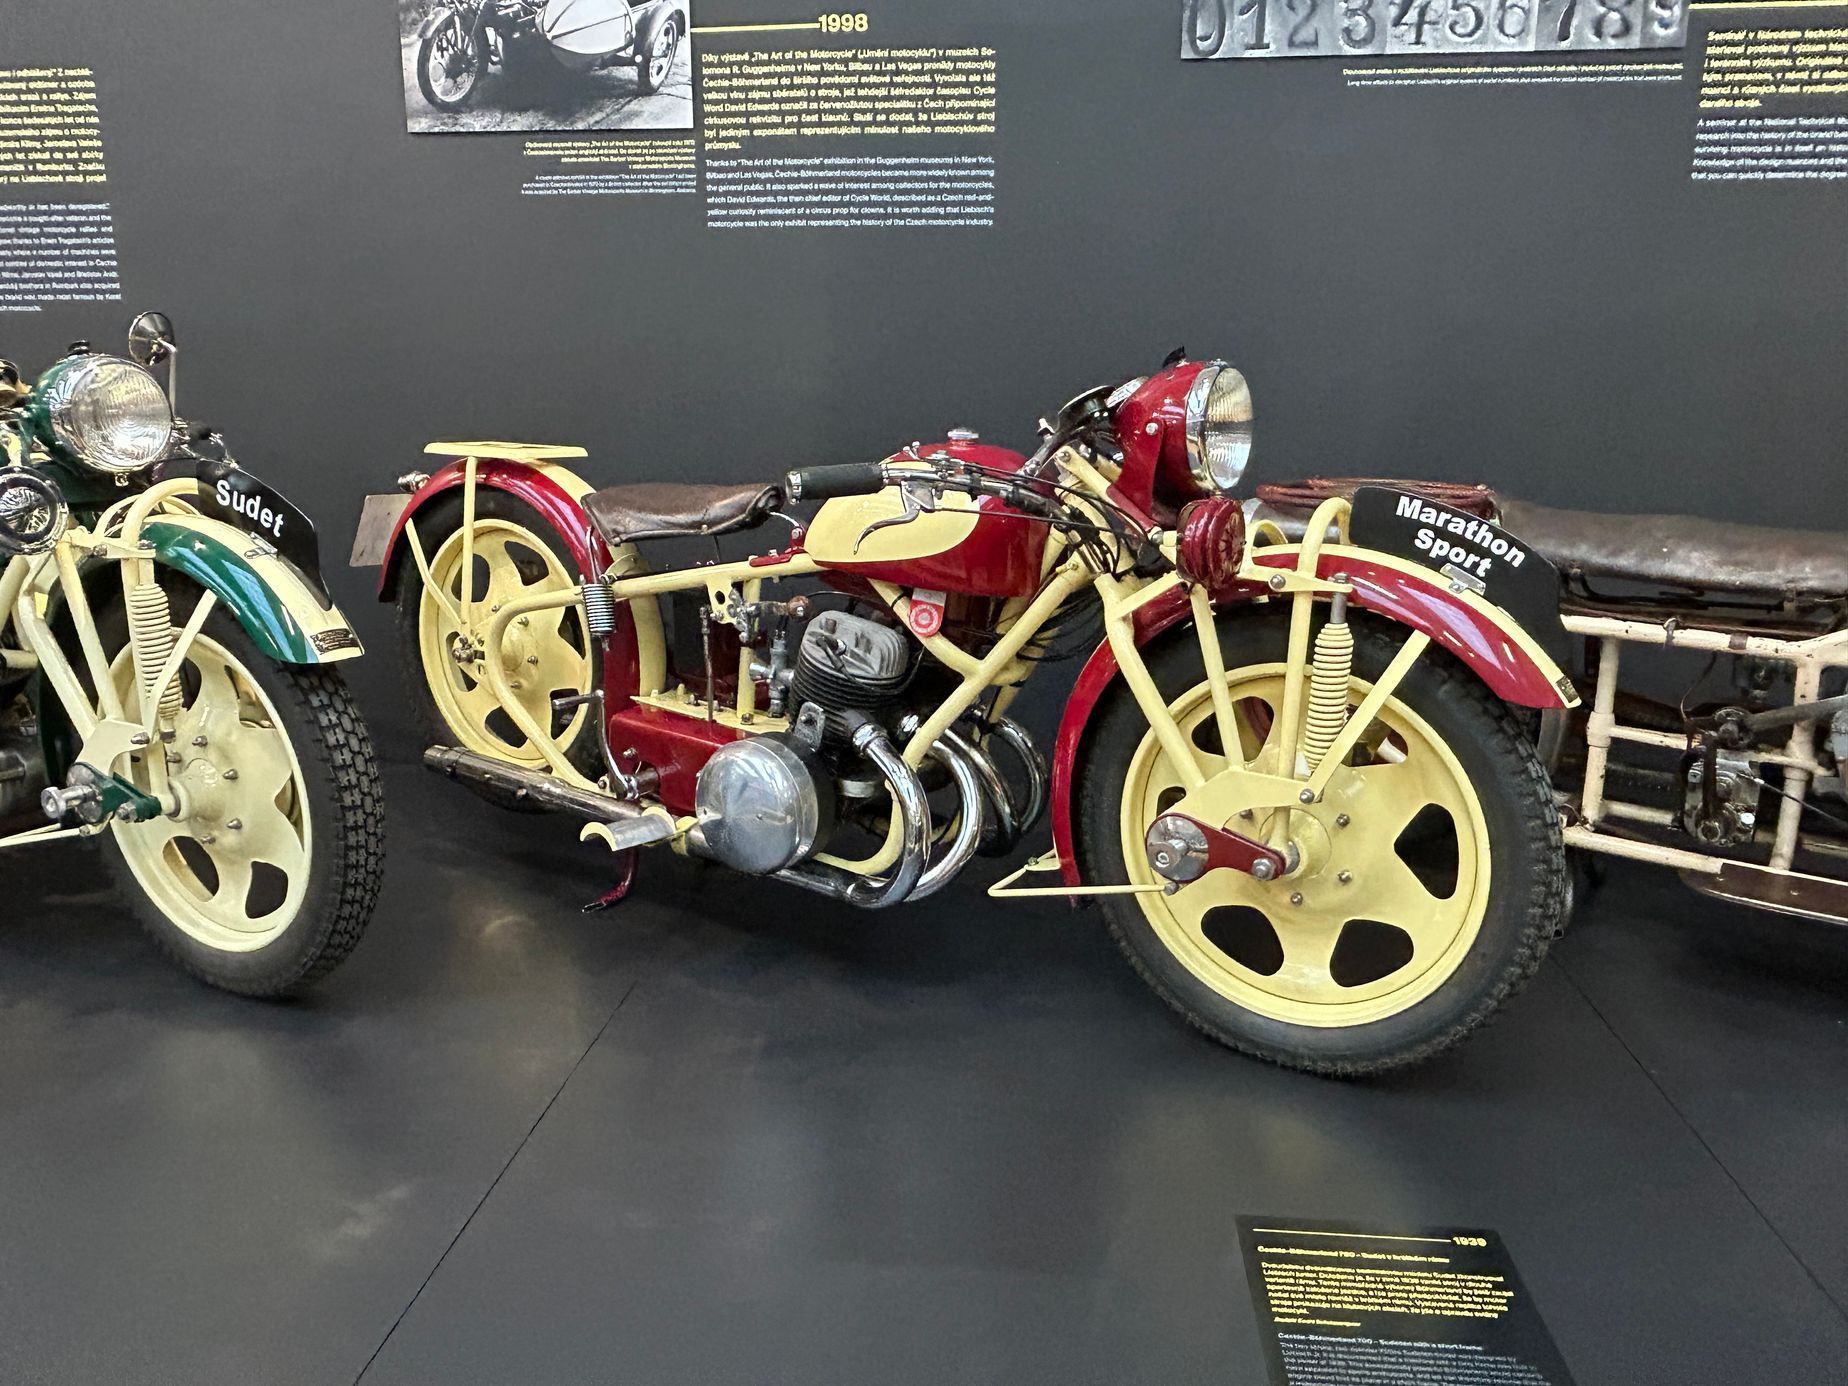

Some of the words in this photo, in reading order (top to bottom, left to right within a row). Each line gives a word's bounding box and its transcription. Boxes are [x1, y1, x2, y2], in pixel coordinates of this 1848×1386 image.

[818, 13, 868, 32] 1998
[216, 479, 284, 537] Sudet
[1395, 495, 1526, 568] Marathon
[1414, 528, 1492, 578] Sport
